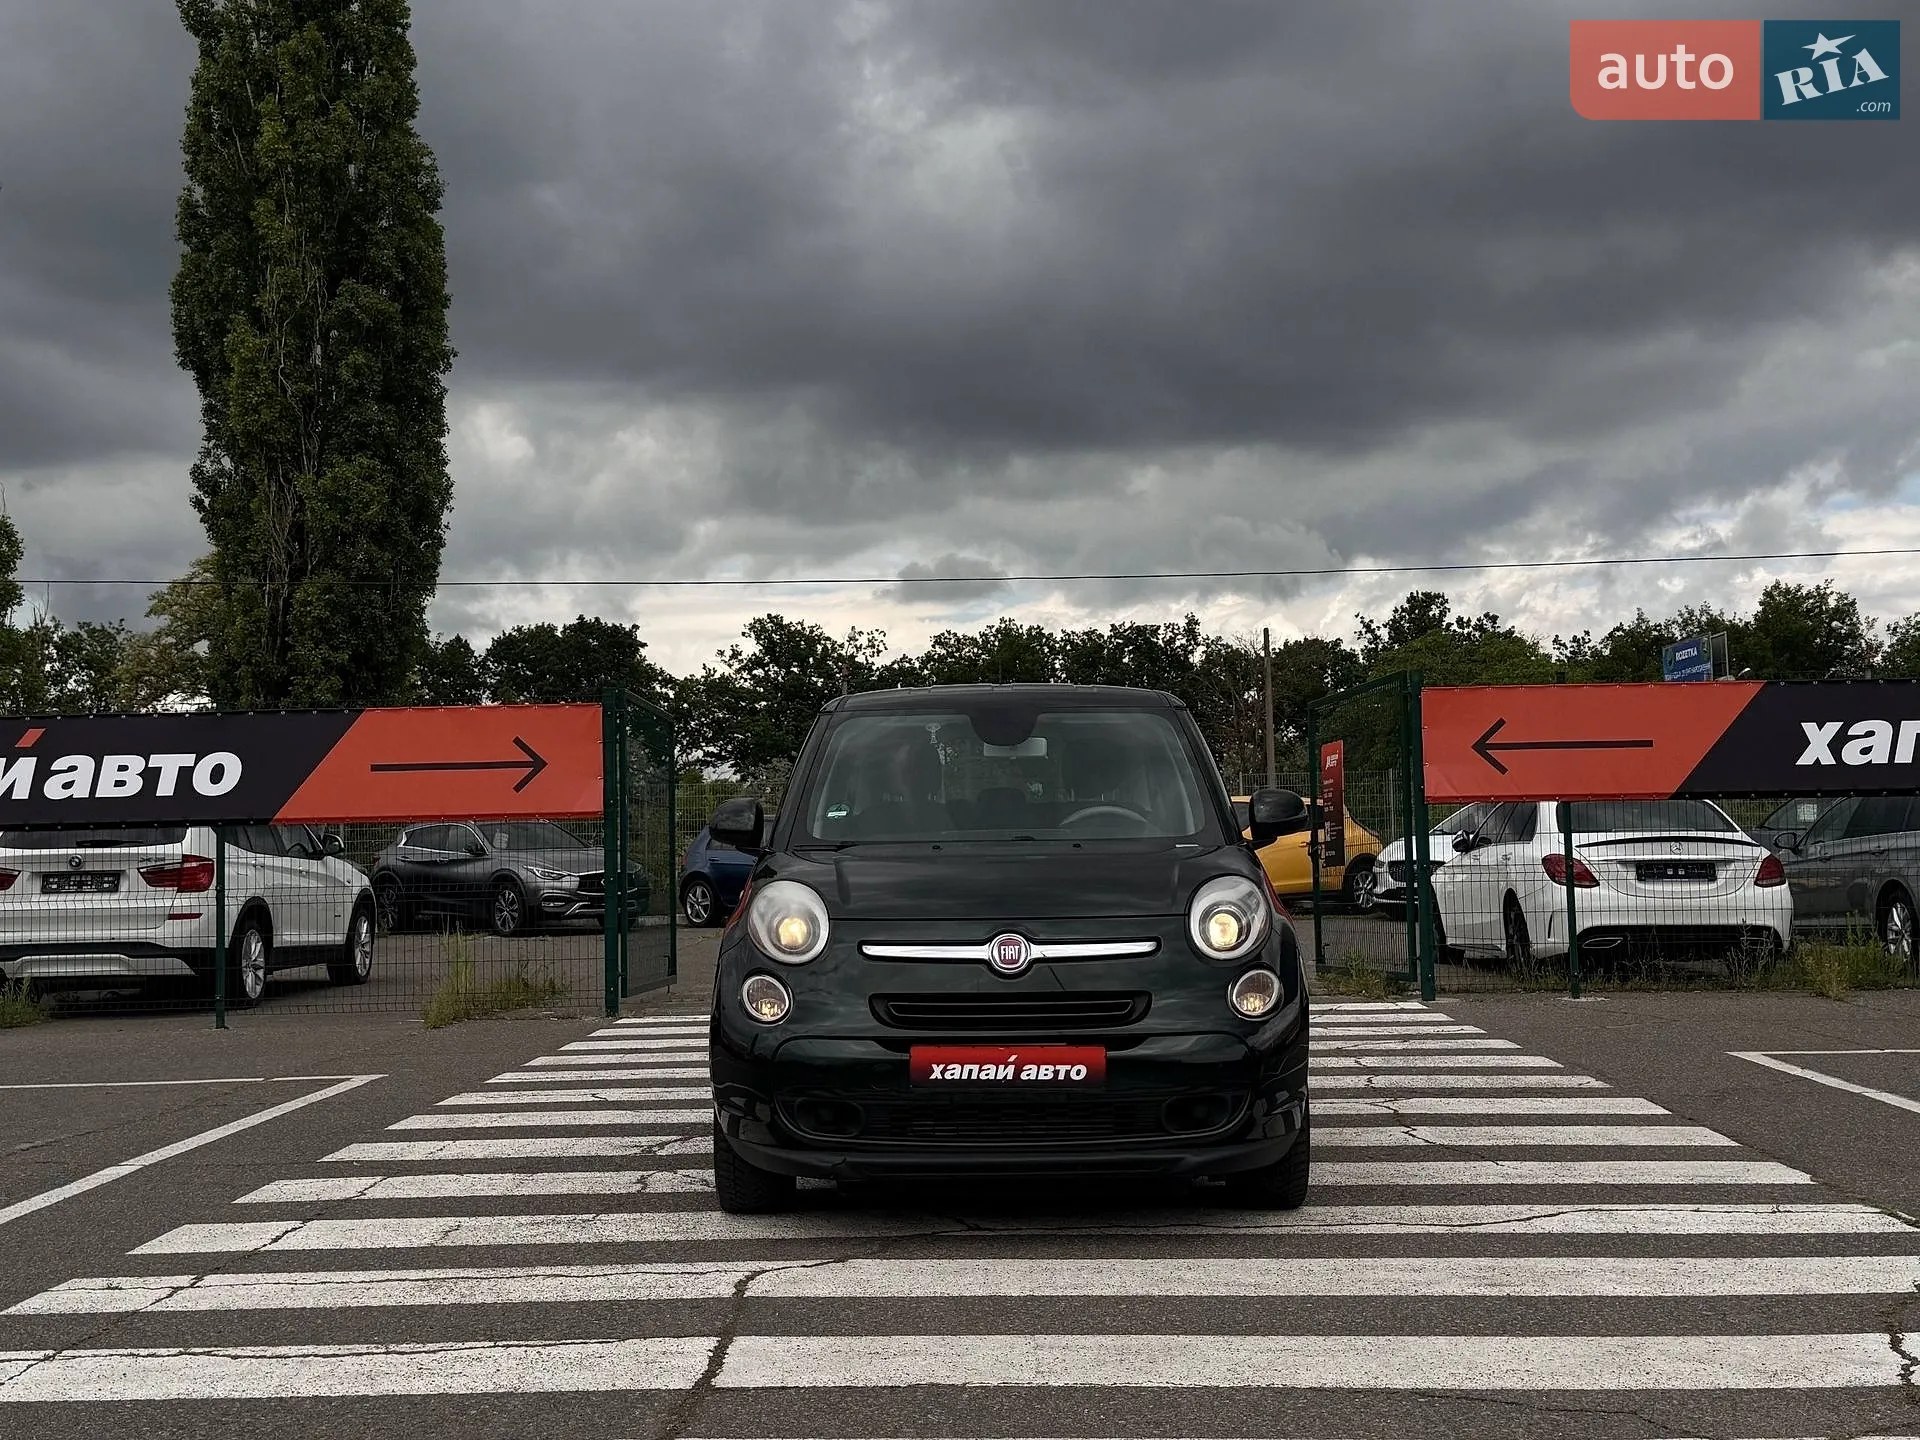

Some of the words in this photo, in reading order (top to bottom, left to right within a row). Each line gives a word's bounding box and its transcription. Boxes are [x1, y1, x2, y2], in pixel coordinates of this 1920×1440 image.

[43, 751, 243, 800] авто
[1000, 945, 1020, 960] FIAT
[929, 1054, 1018, 1081] хапай
[1020, 1064, 1087, 1081] авто
